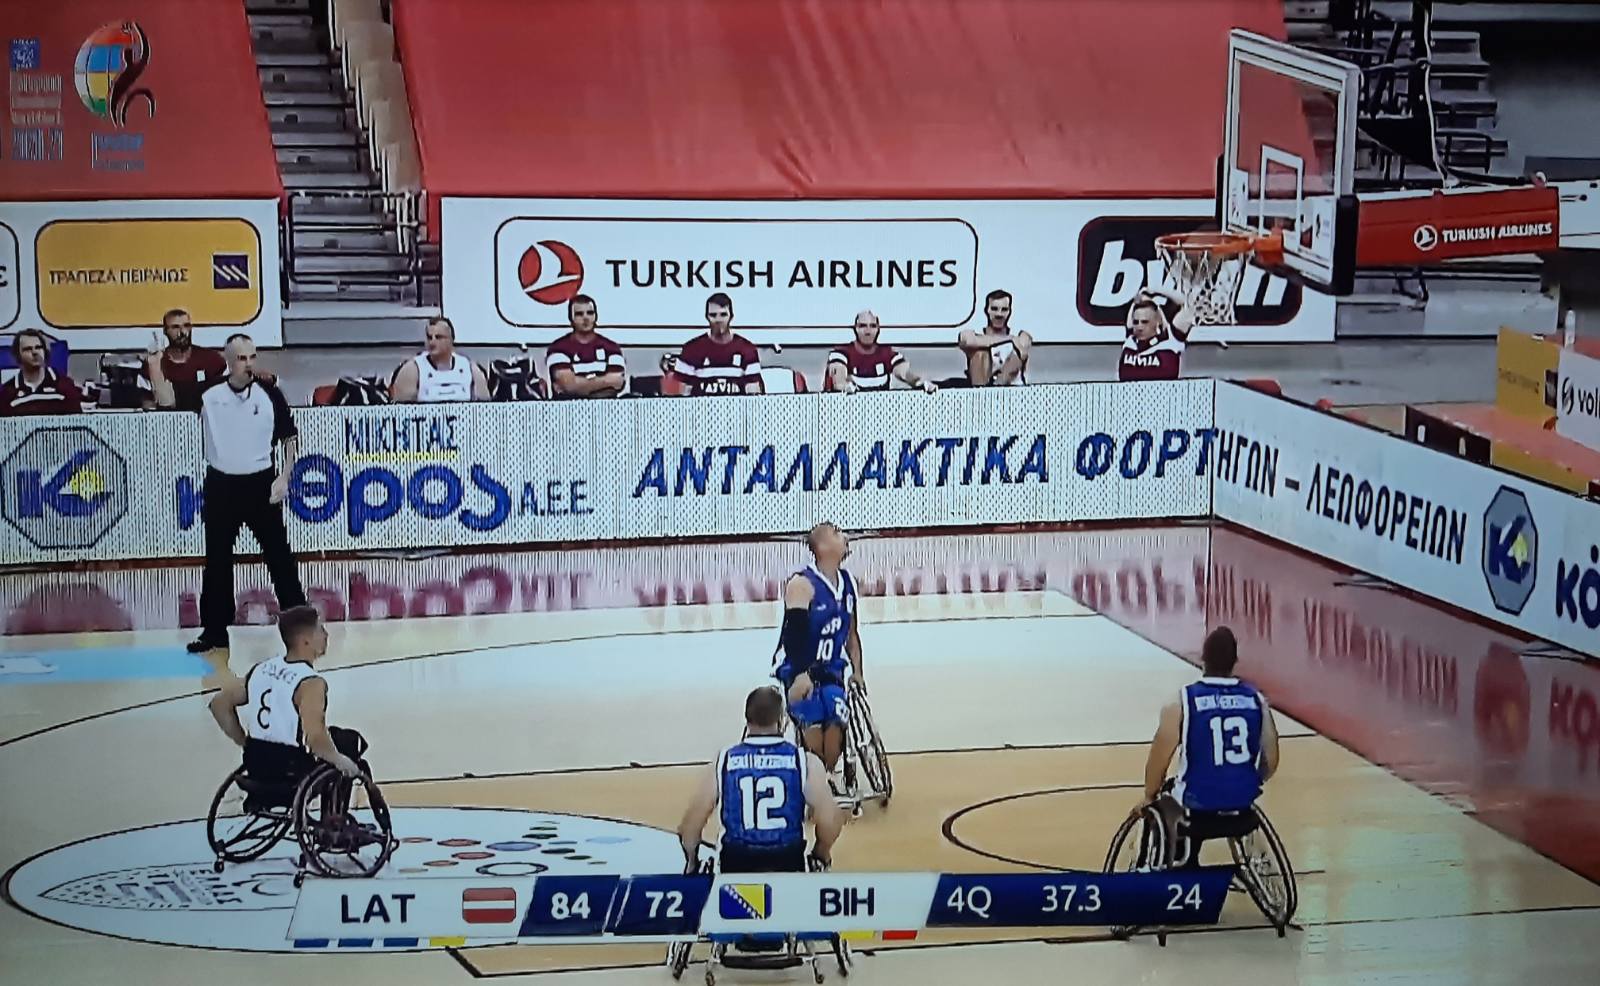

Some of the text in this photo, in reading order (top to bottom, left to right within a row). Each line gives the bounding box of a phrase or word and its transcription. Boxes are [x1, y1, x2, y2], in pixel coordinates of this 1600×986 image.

[1442, 226, 1496, 244] TURKISH
[605, 259, 958, 288] TURKISH AIRLINES
[632, 434, 1049, 498] ΑΝΤΑΛΛΑΚΤΙΚΑ
[1306, 463, 1467, 565] ΛΕΩΦΟΡΕΙΩΝ
[816, 638, 834, 661] 10
[1209, 716, 1250, 766] 13
[739, 776, 787, 830] 12
